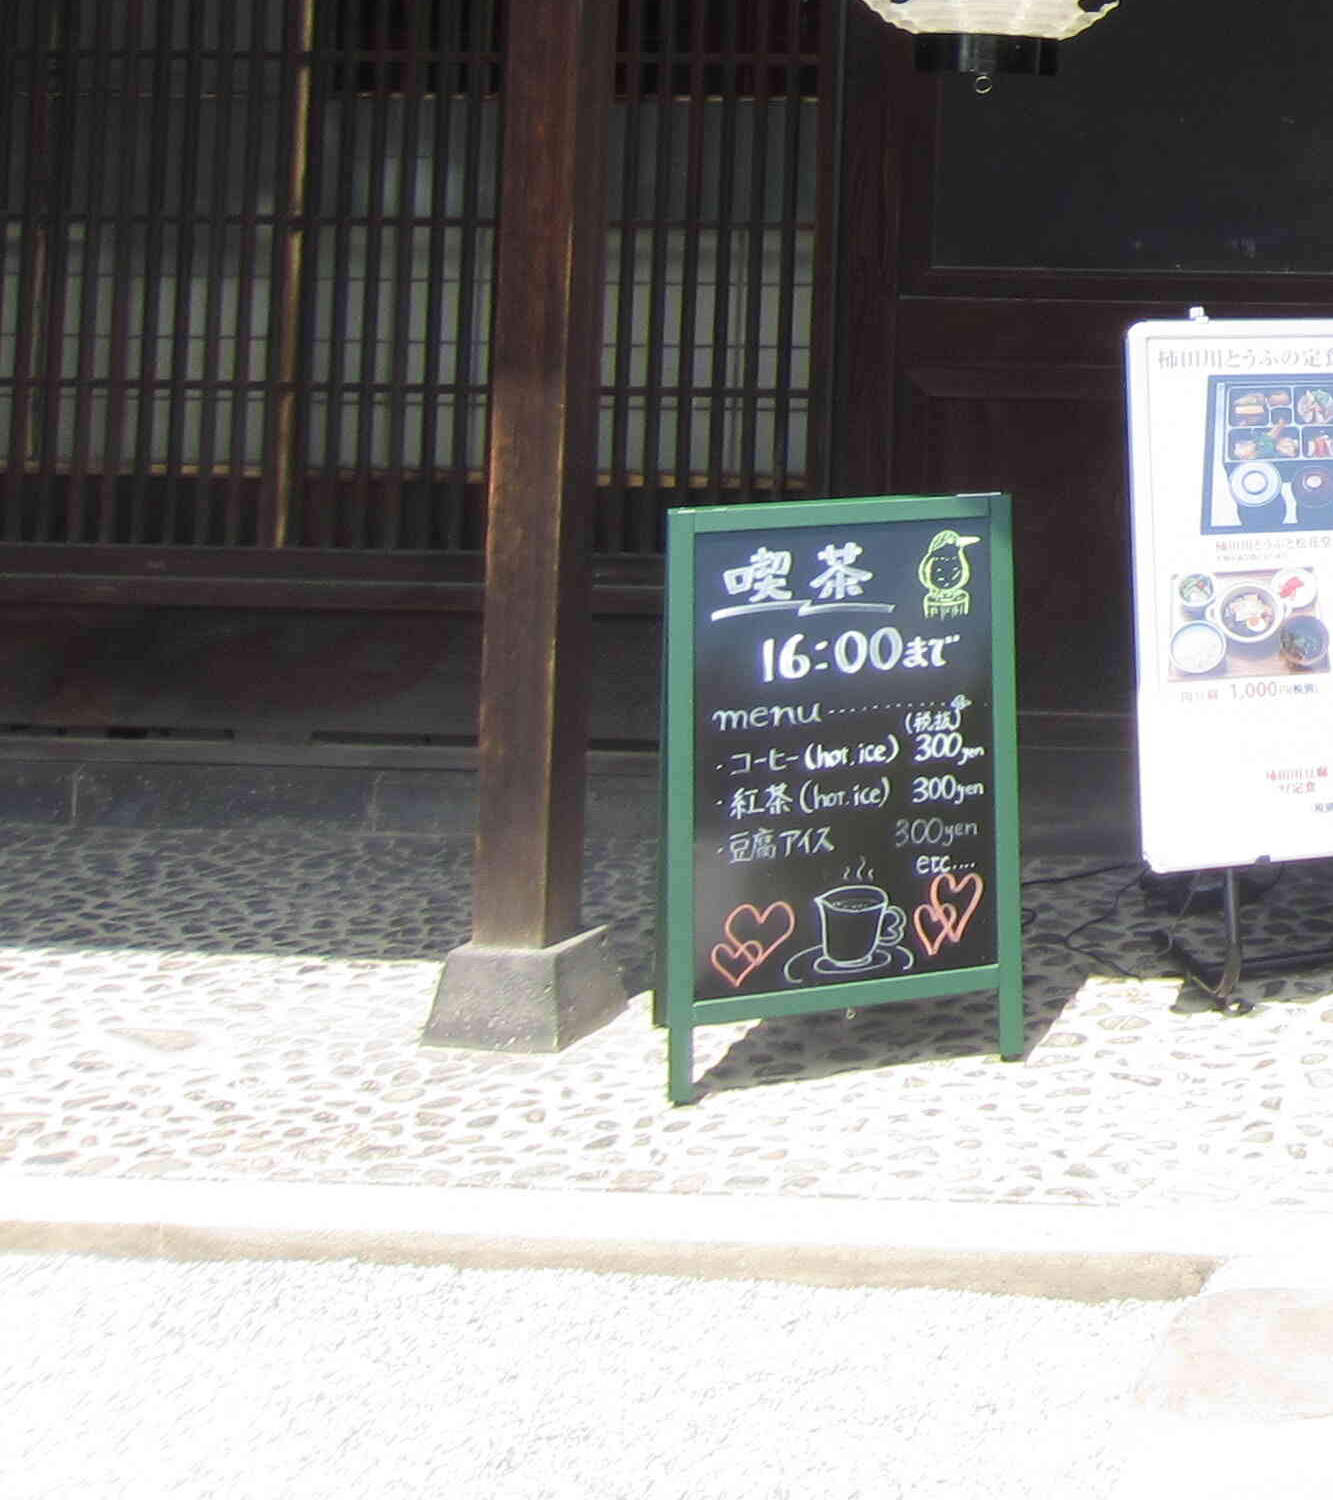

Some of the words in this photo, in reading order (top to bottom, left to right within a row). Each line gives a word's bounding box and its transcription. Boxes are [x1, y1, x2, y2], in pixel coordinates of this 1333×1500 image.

[722, 542, 873, 602] 喫茶
[761, 626, 961, 682] 16:00まで
[711, 702, 823, 732] menu
[729, 826, 835, 864] 豆腐アイス
